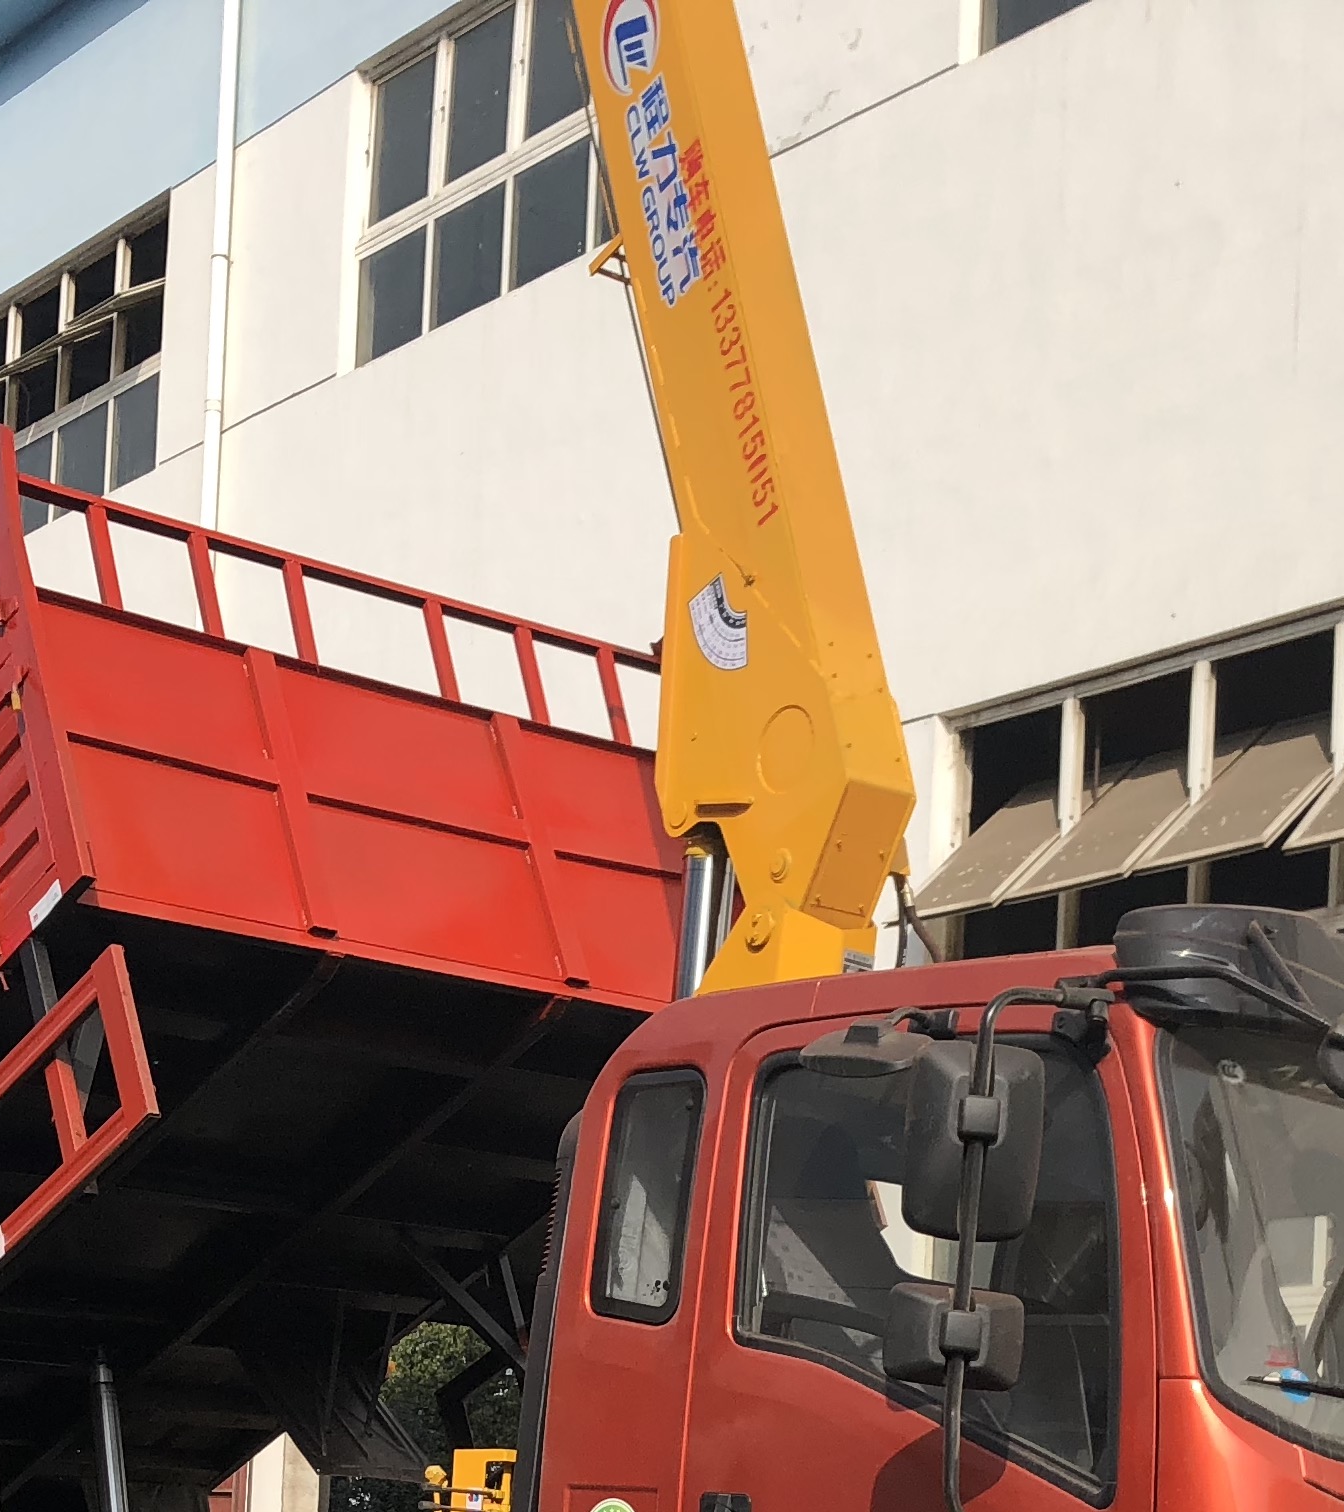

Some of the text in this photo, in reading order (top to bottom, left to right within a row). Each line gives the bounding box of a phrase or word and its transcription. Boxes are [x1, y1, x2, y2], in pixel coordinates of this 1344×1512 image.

[627, 105, 676, 306] CLW GROUP
[641, 77, 701, 294] 程力专汽
